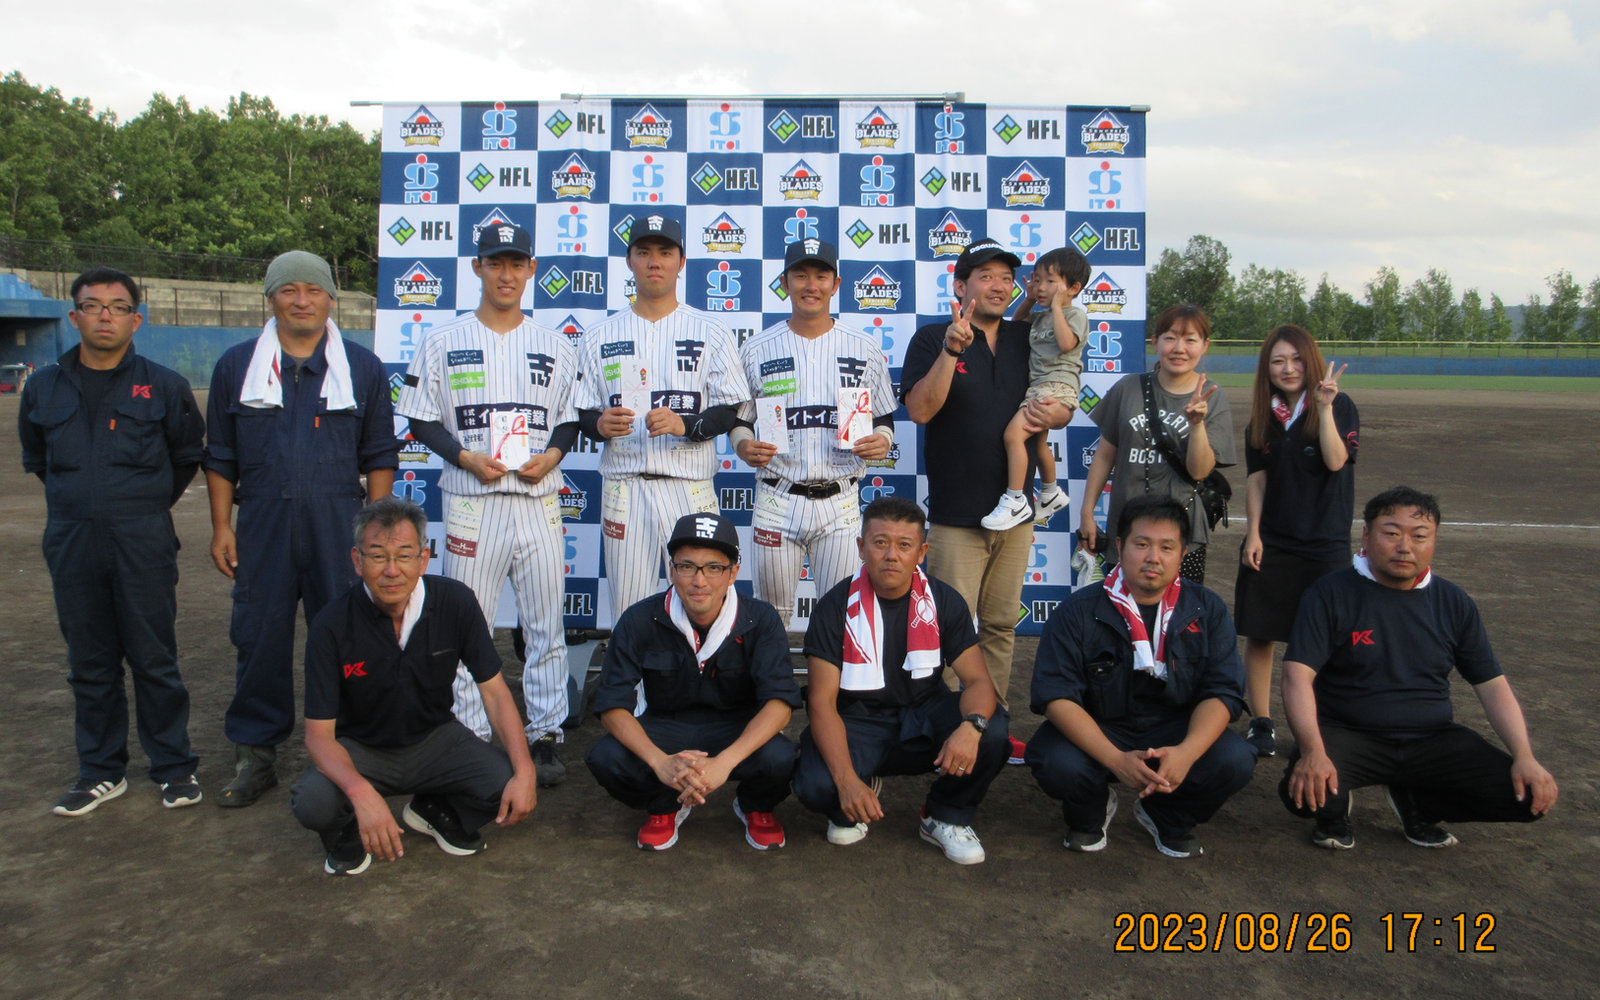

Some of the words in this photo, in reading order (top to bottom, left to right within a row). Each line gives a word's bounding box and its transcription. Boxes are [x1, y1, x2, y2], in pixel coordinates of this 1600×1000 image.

[576, 112, 606, 134] HFL
[802, 115, 835, 138] HFL
[1026, 119, 1061, 140] HFL
[400, 126, 445, 138] BLADES
[627, 126, 671, 138] BLADES
[855, 128, 900, 139] BLADES
[1083, 132, 1129, 142] BLADES
[482, 137, 516, 150] ITOI
[710, 139, 740, 150] ITOI
[936, 139, 965, 153] ITOI
[499, 167, 532, 187] HFL
[554, 177, 595, 189] BLADES
[724, 167, 759, 190] HFL
[951, 171, 982, 193] HFL
[779, 180, 823, 191] BLADES
[1003, 185, 1049, 195] BLADES
[404, 190, 438, 203] ITOI
[632, 191, 663, 202] ITOI
[861, 193, 894, 206] ITOI
[1089, 198, 1121, 209] ITOI
[420, 221, 453, 241] HFL
[878, 223, 910, 244] HFL
[703, 233, 746, 244] BLADES
[930, 237, 971, 247] BLADES
[1104, 228, 1140, 250] HFL
[557, 241, 587, 253] ITOI
[572, 270, 604, 295] HFL
[396, 285, 440, 295] BLADES
[856, 288, 900, 299] BLADES
[707, 297, 741, 311] ITOI
[1082, 294, 1127, 305] BLADES
[1088, 358, 1122, 373] ITOI
[787, 409, 839, 426] イトイ産
[1128, 409, 1191, 439] PRPERT
[559, 498, 586, 508] ADES
[720, 487, 756, 510] HFL
[563, 593, 593, 616] HFL
